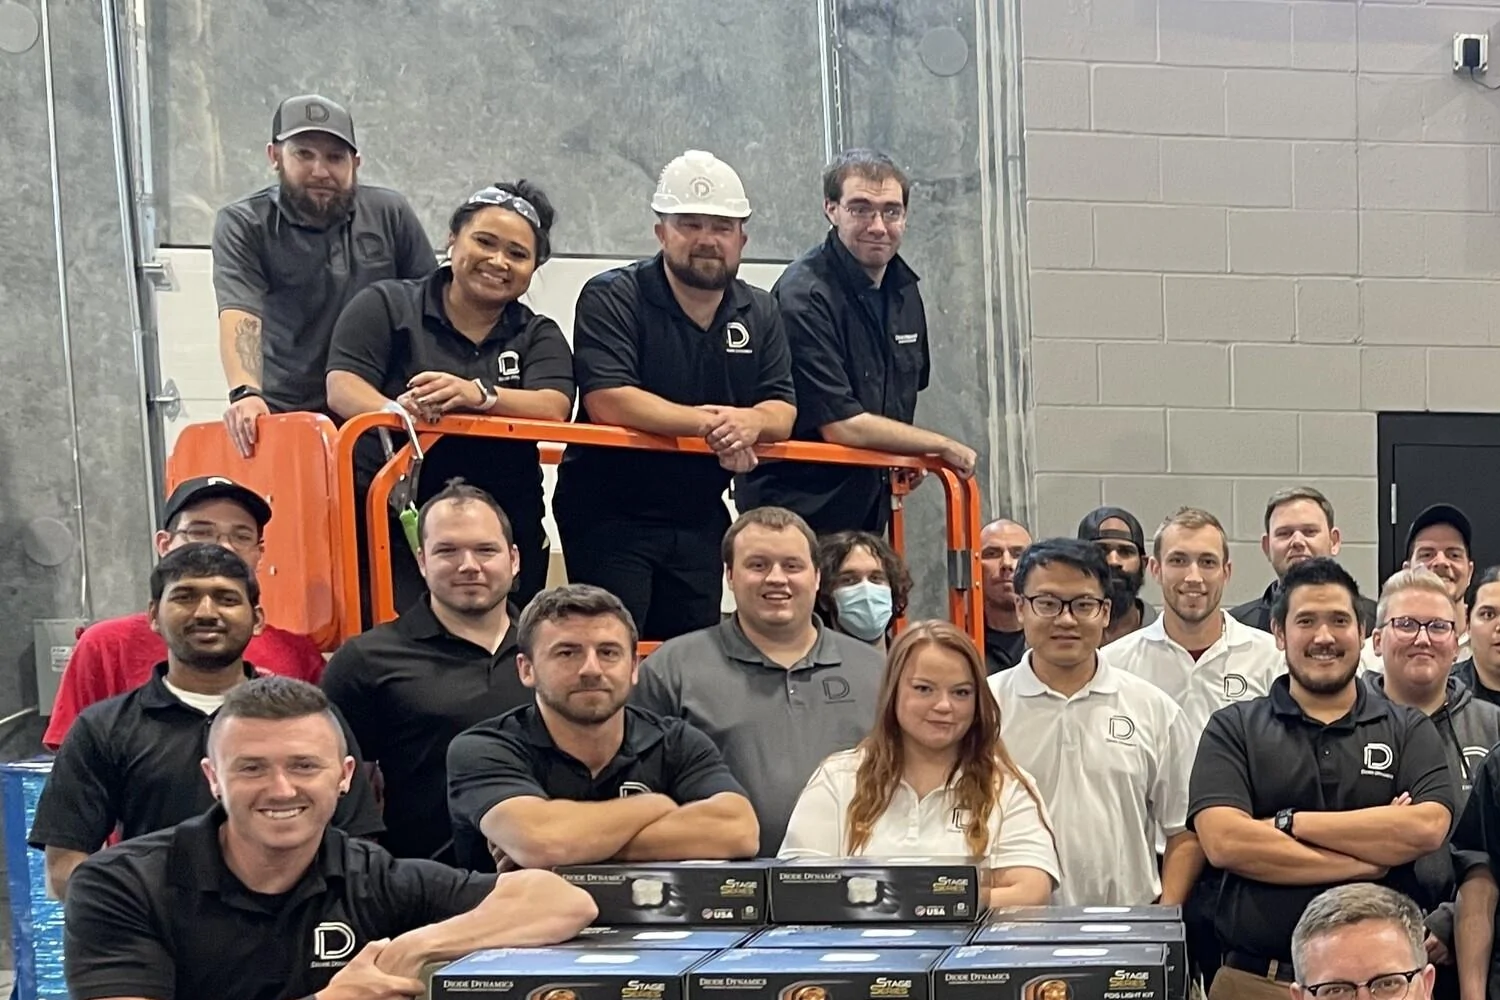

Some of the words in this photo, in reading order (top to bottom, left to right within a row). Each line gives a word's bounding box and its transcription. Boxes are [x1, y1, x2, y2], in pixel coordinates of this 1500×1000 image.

[726, 879, 757, 889] STAGE
[938, 876, 968, 886] STAGE
[1115, 970, 1149, 981] STAGE
[628, 980, 664, 991] STAGE
[876, 978, 911, 988] STAGE
